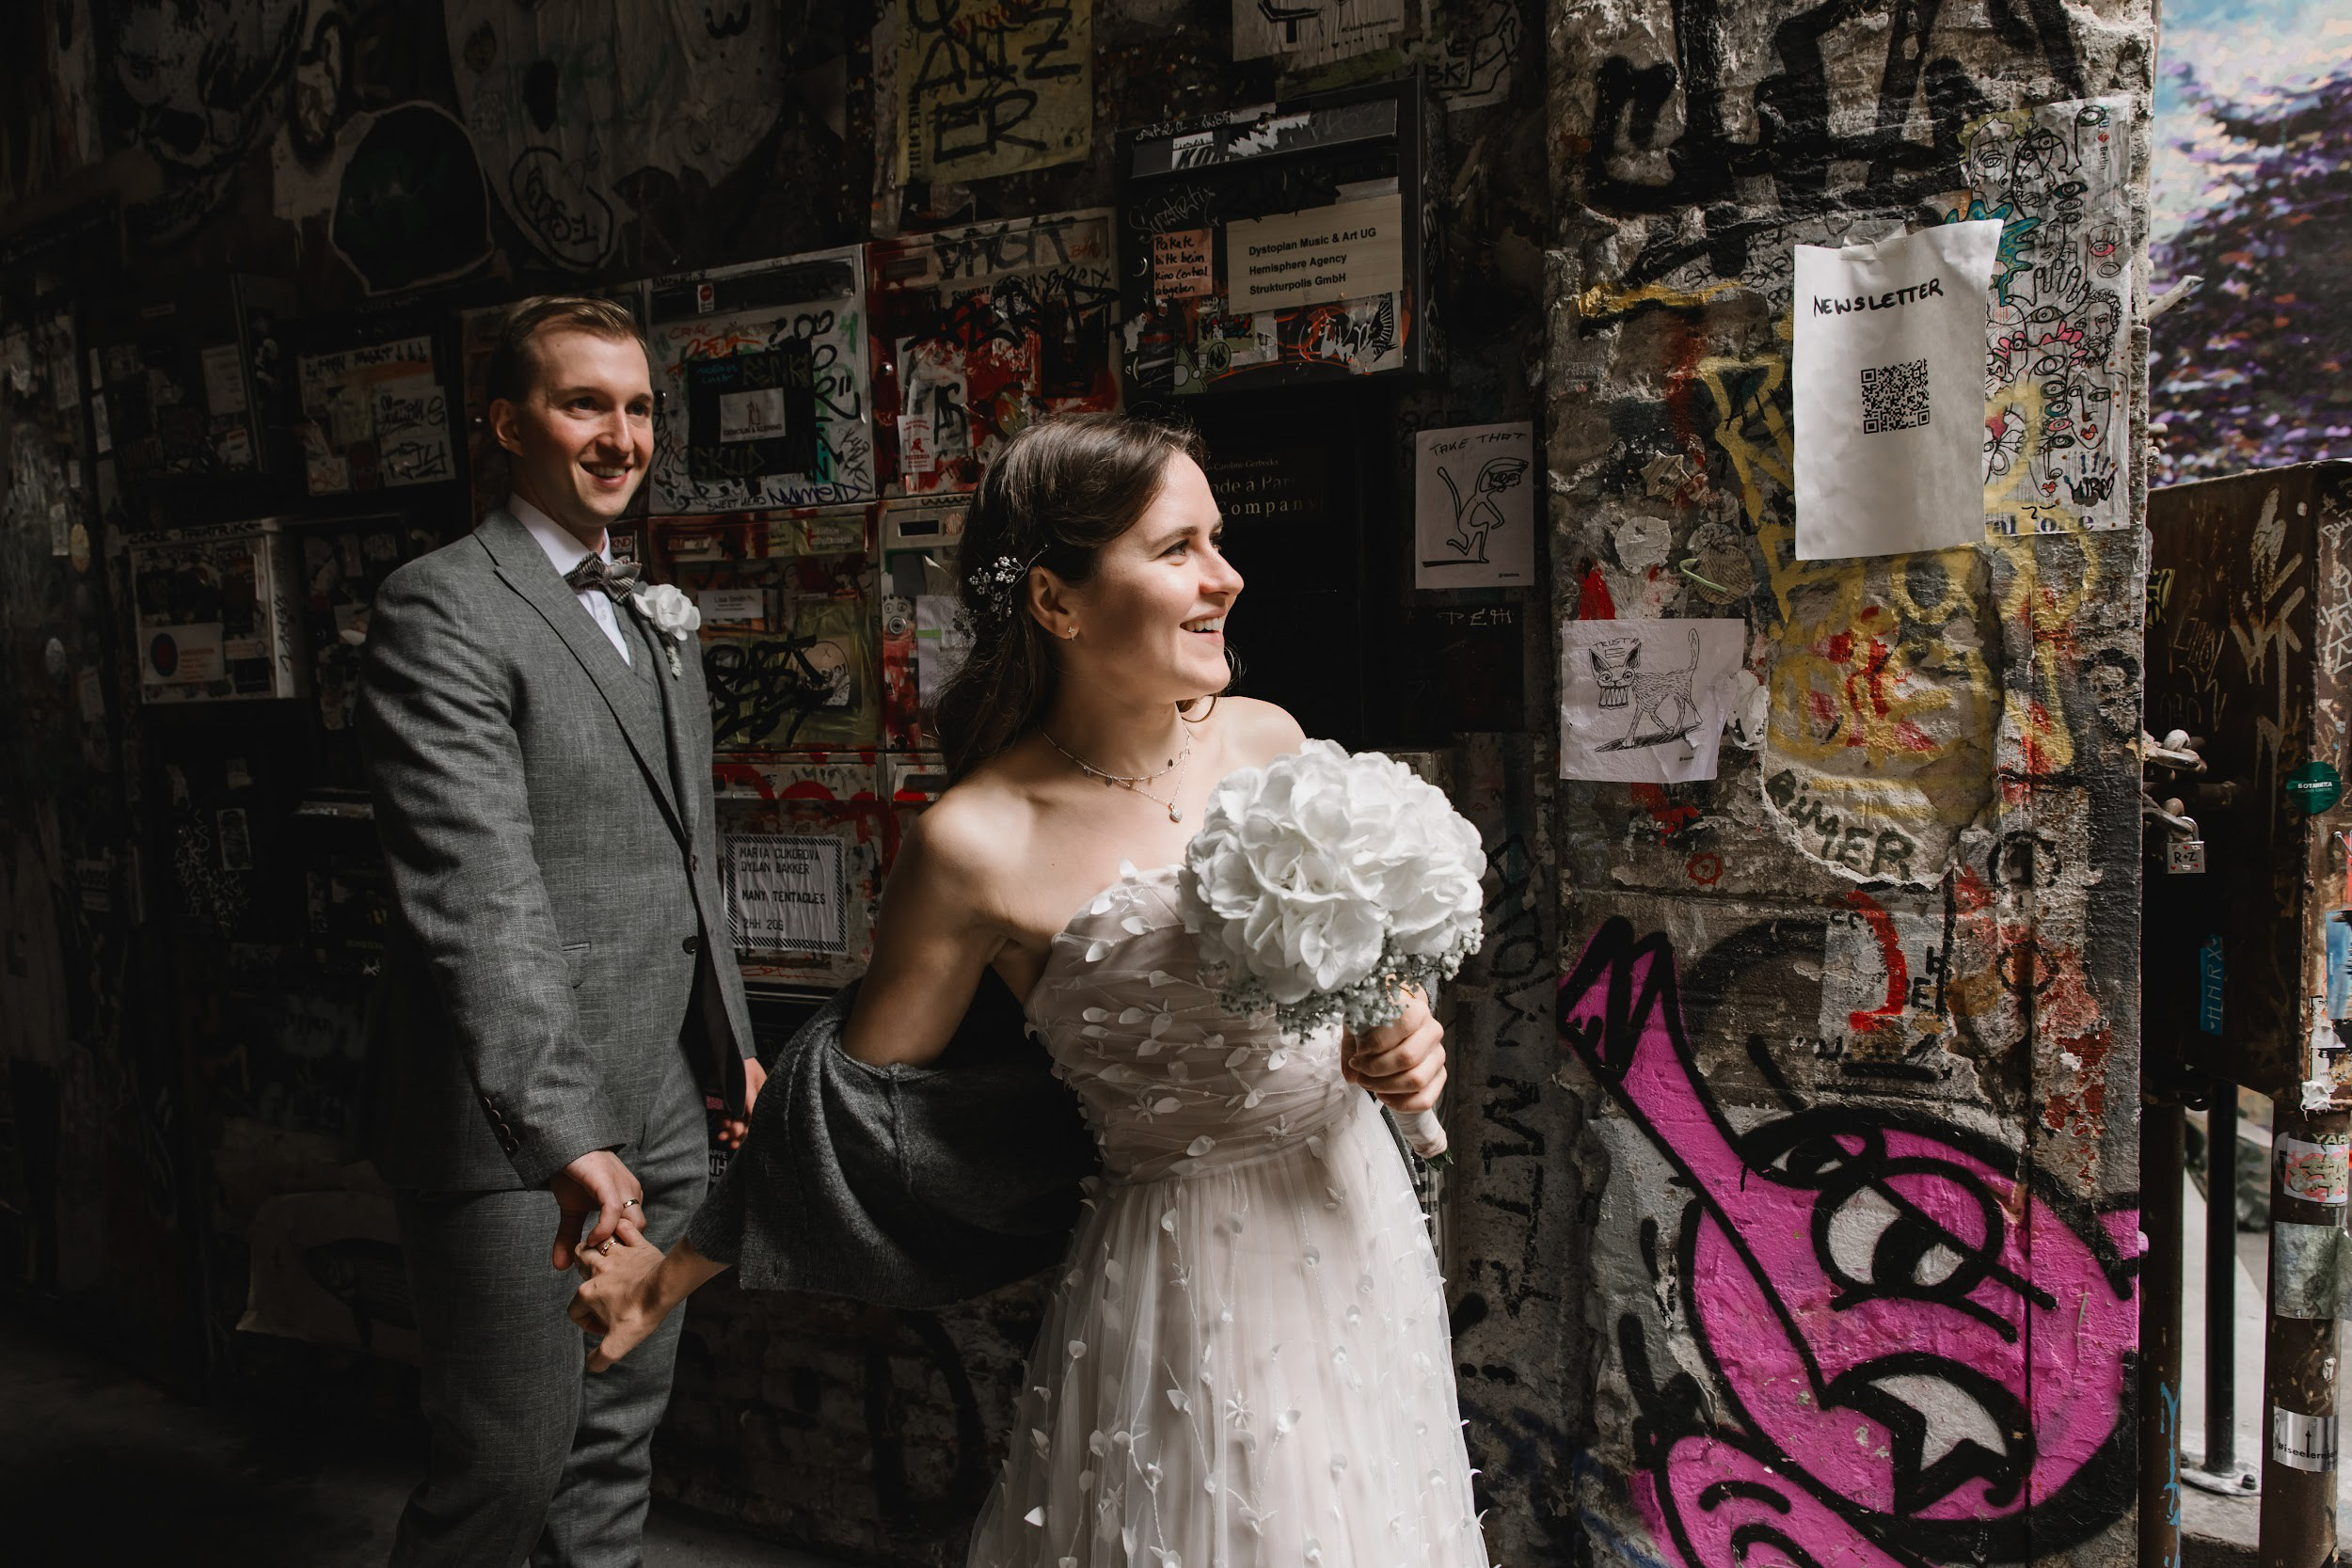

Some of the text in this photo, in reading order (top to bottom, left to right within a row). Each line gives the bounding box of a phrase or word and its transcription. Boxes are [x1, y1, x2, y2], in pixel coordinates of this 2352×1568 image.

[2100, 146, 2109, 169] Berlin
[1155, 236, 1195, 250] Pakete
[1248, 228, 1376, 257] Dystopian Music & Art UG
[1181, 251, 1204, 263] beim
[1249, 255, 1347, 275] Hemisphere Agency
[1155, 283, 1195, 299] abgeben
[1249, 273, 1346, 295] Strukturpolis GmbH
[1813, 277, 1944, 318] NEWSLETTER
[1429, 432, 1527, 456] TAKE THAT
[739, 847, 770, 860] MARIA
[741, 862, 810, 875] DYLAN BAKKER
[742, 890, 826, 905] MANY TENTACLES
